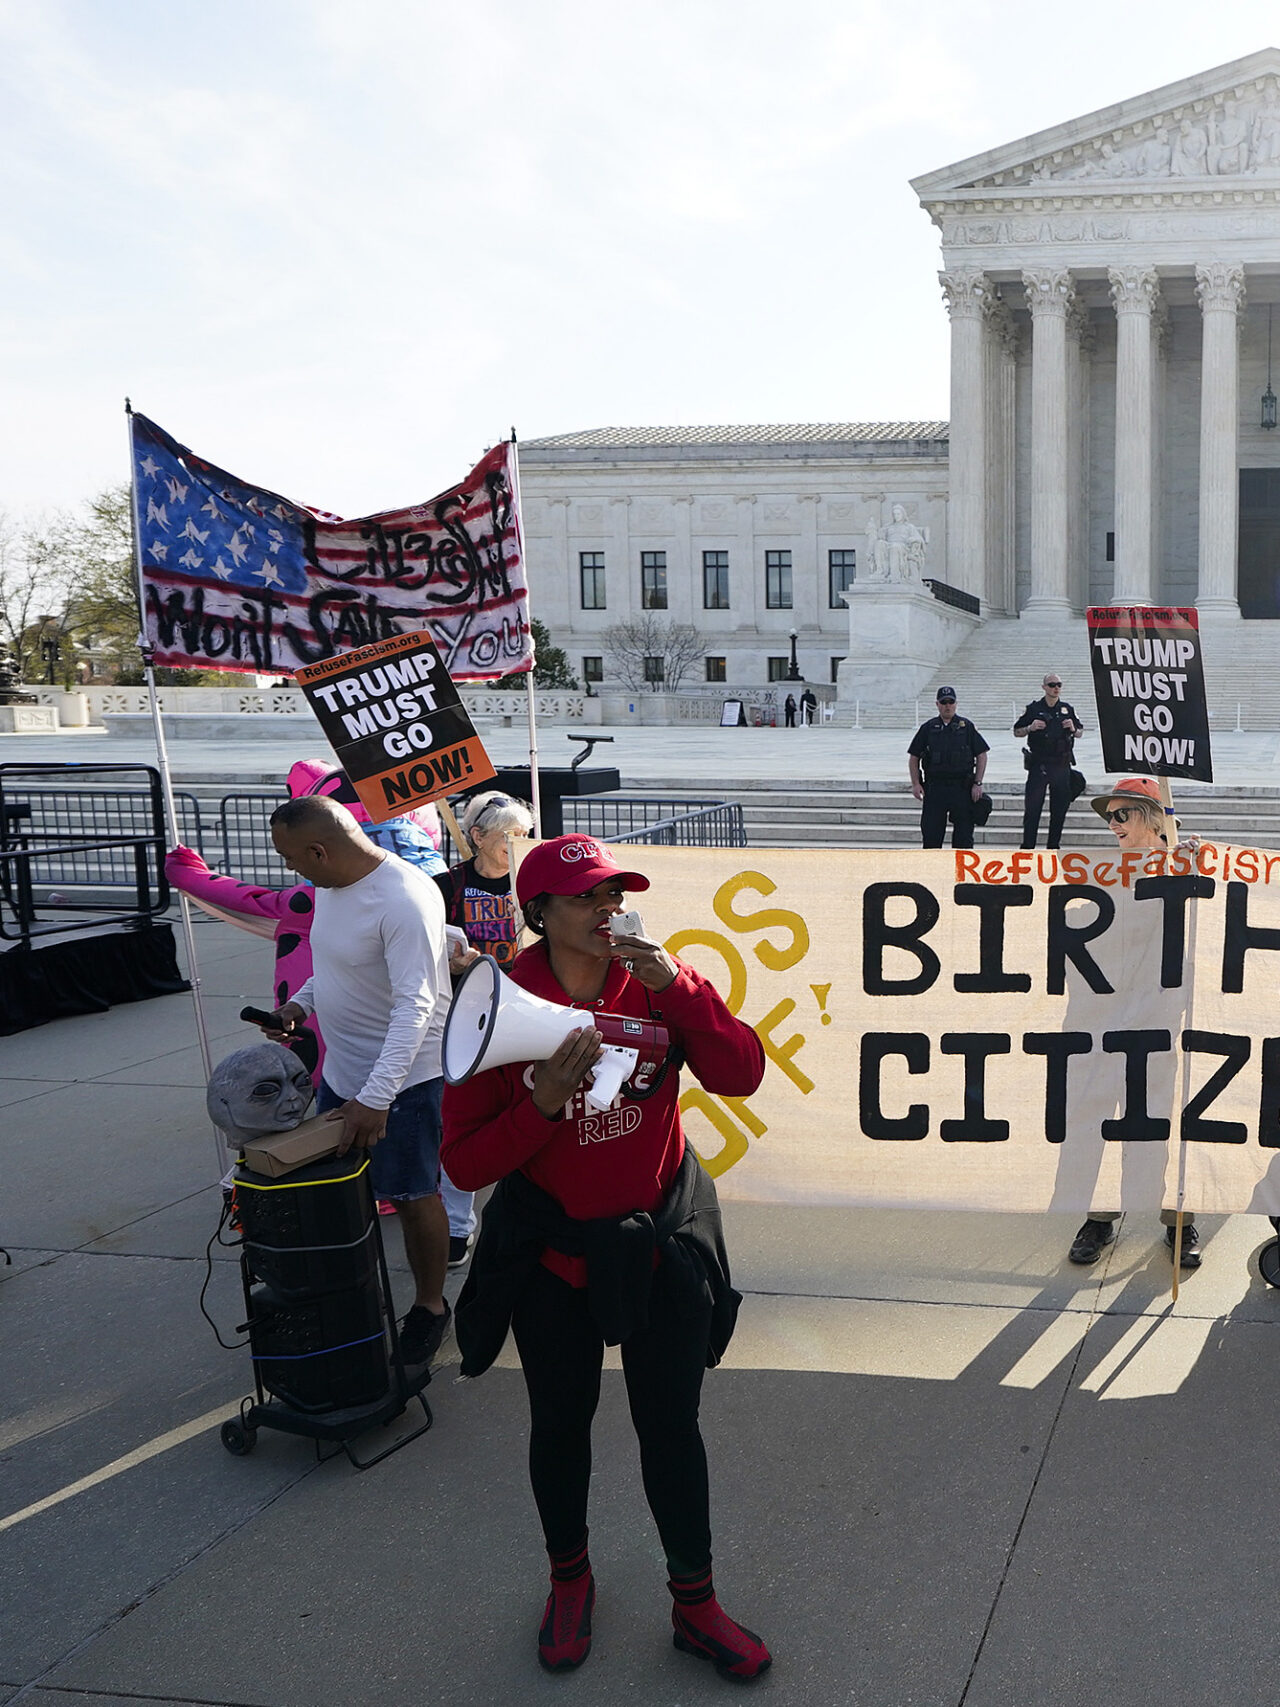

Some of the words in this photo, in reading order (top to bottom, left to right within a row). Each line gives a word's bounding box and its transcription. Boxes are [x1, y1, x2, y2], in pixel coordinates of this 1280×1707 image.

[303, 634, 421, 679] RefuseFascism.org
[1094, 638, 1195, 668] TRUMP
[313, 652, 436, 713] TRUMP
[1110, 671, 1187, 702] MUST
[341, 684, 438, 741] MUST
[1134, 703, 1174, 733] GO
[383, 722, 434, 760] GO
[1125, 733, 1195, 767] NOW!
[381, 746, 473, 806] NOW!
[466, 921, 507, 941] MUST
[578, 1105, 643, 1146] RED
